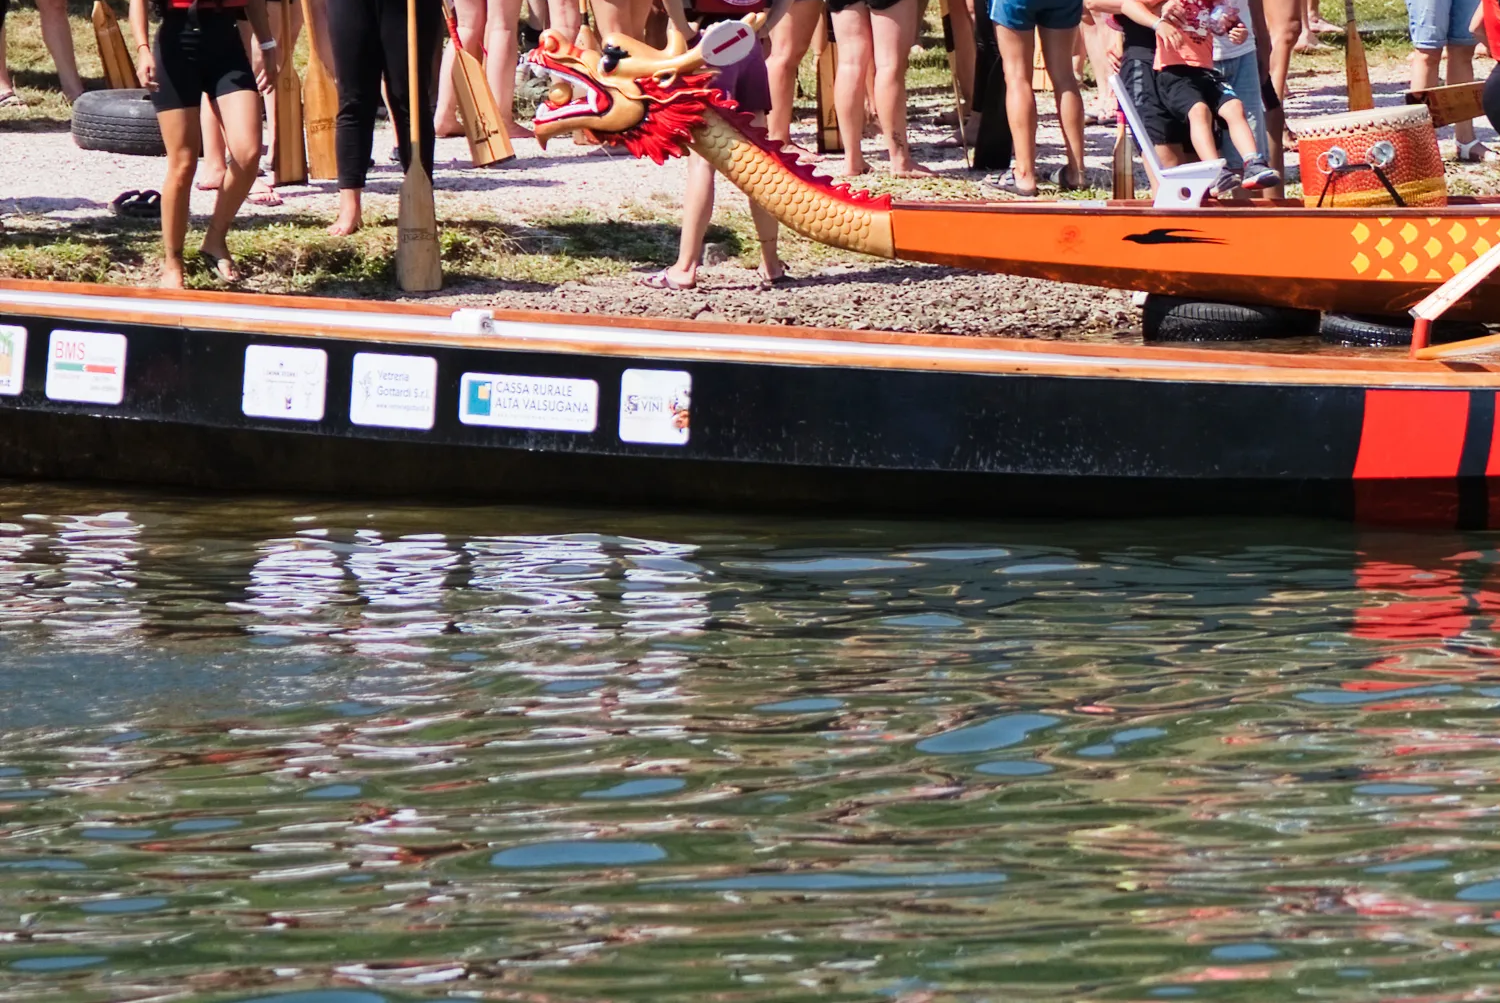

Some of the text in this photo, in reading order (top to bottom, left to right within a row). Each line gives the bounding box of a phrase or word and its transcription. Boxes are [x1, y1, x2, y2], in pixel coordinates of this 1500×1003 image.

[55, 340, 86, 362] BMS
[496, 381, 573, 398] CASSA RURALE
[495, 396, 590, 414] ALTA VALSUGANA
[641, 399, 664, 414] VINI
